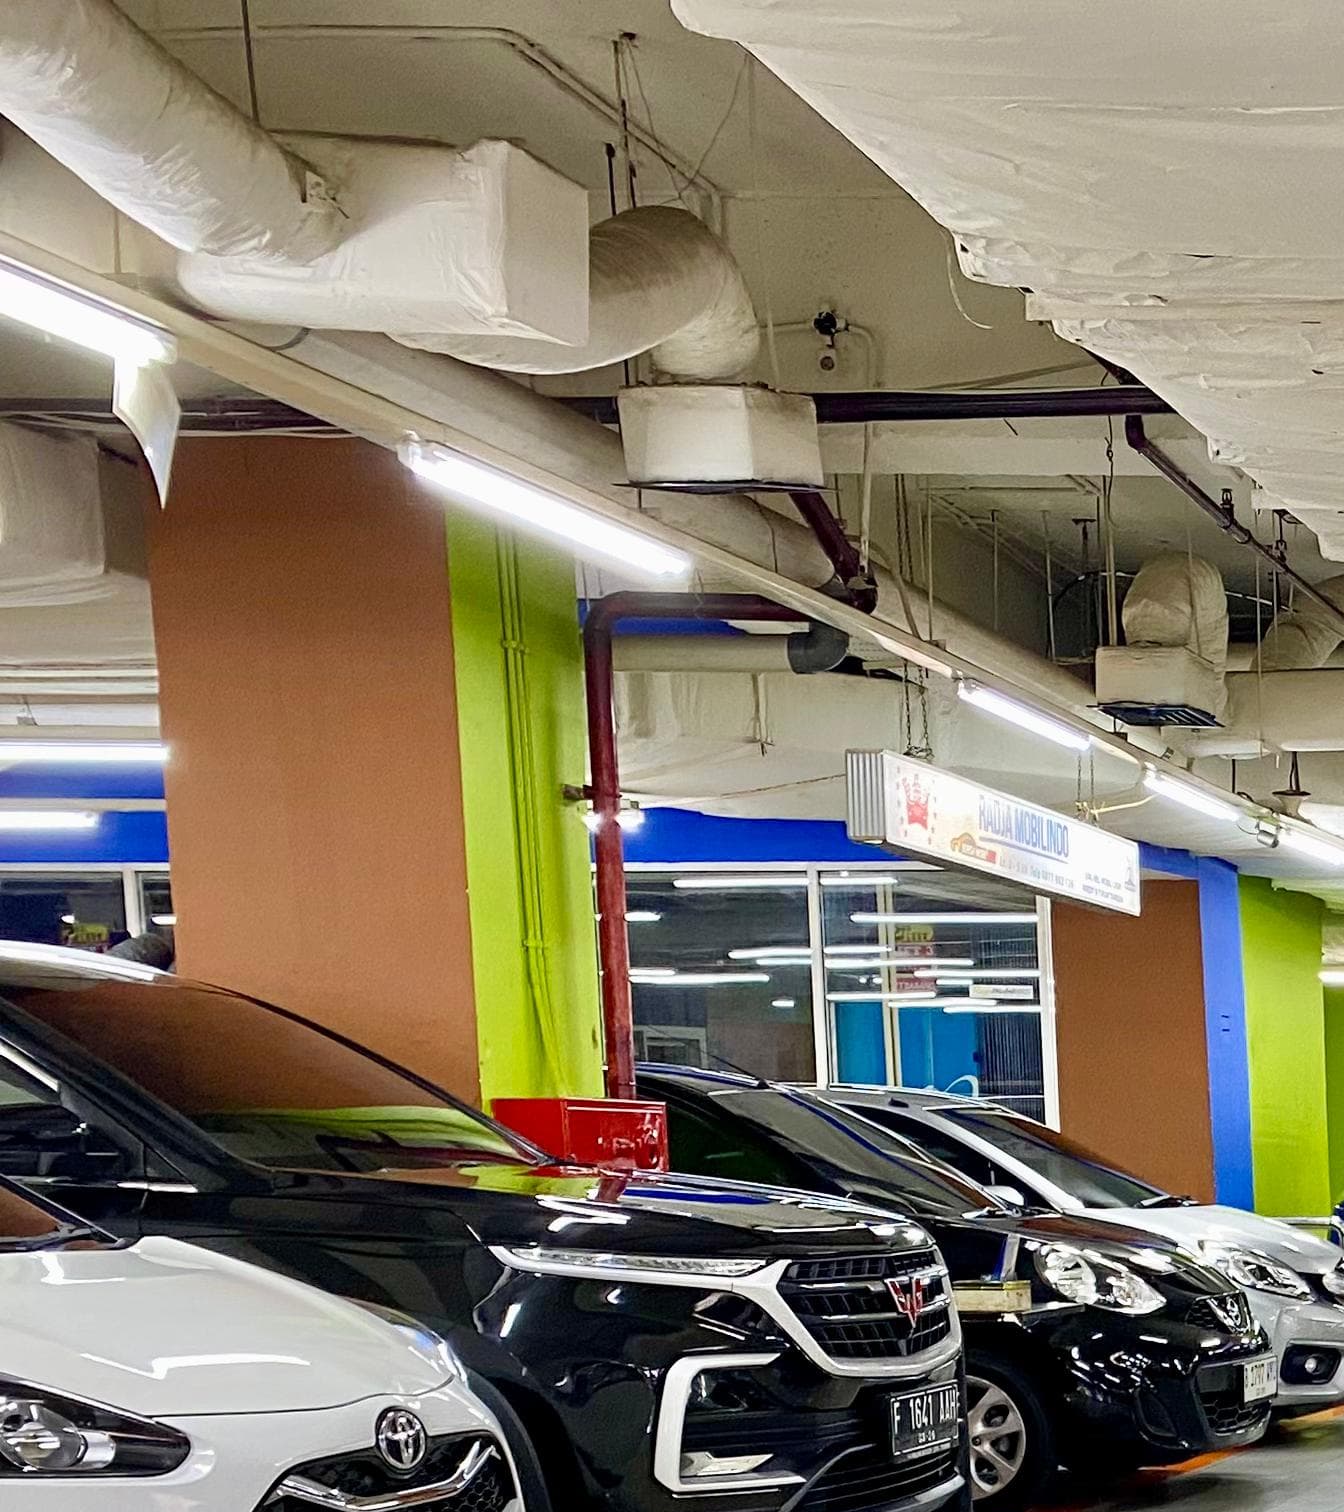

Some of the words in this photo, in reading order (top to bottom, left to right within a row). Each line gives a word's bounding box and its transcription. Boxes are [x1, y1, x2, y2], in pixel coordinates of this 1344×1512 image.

[1015, 807, 1069, 858] MOBILINDO
[893, 1401, 901, 1435] F
[909, 1394, 933, 1430] 1641
